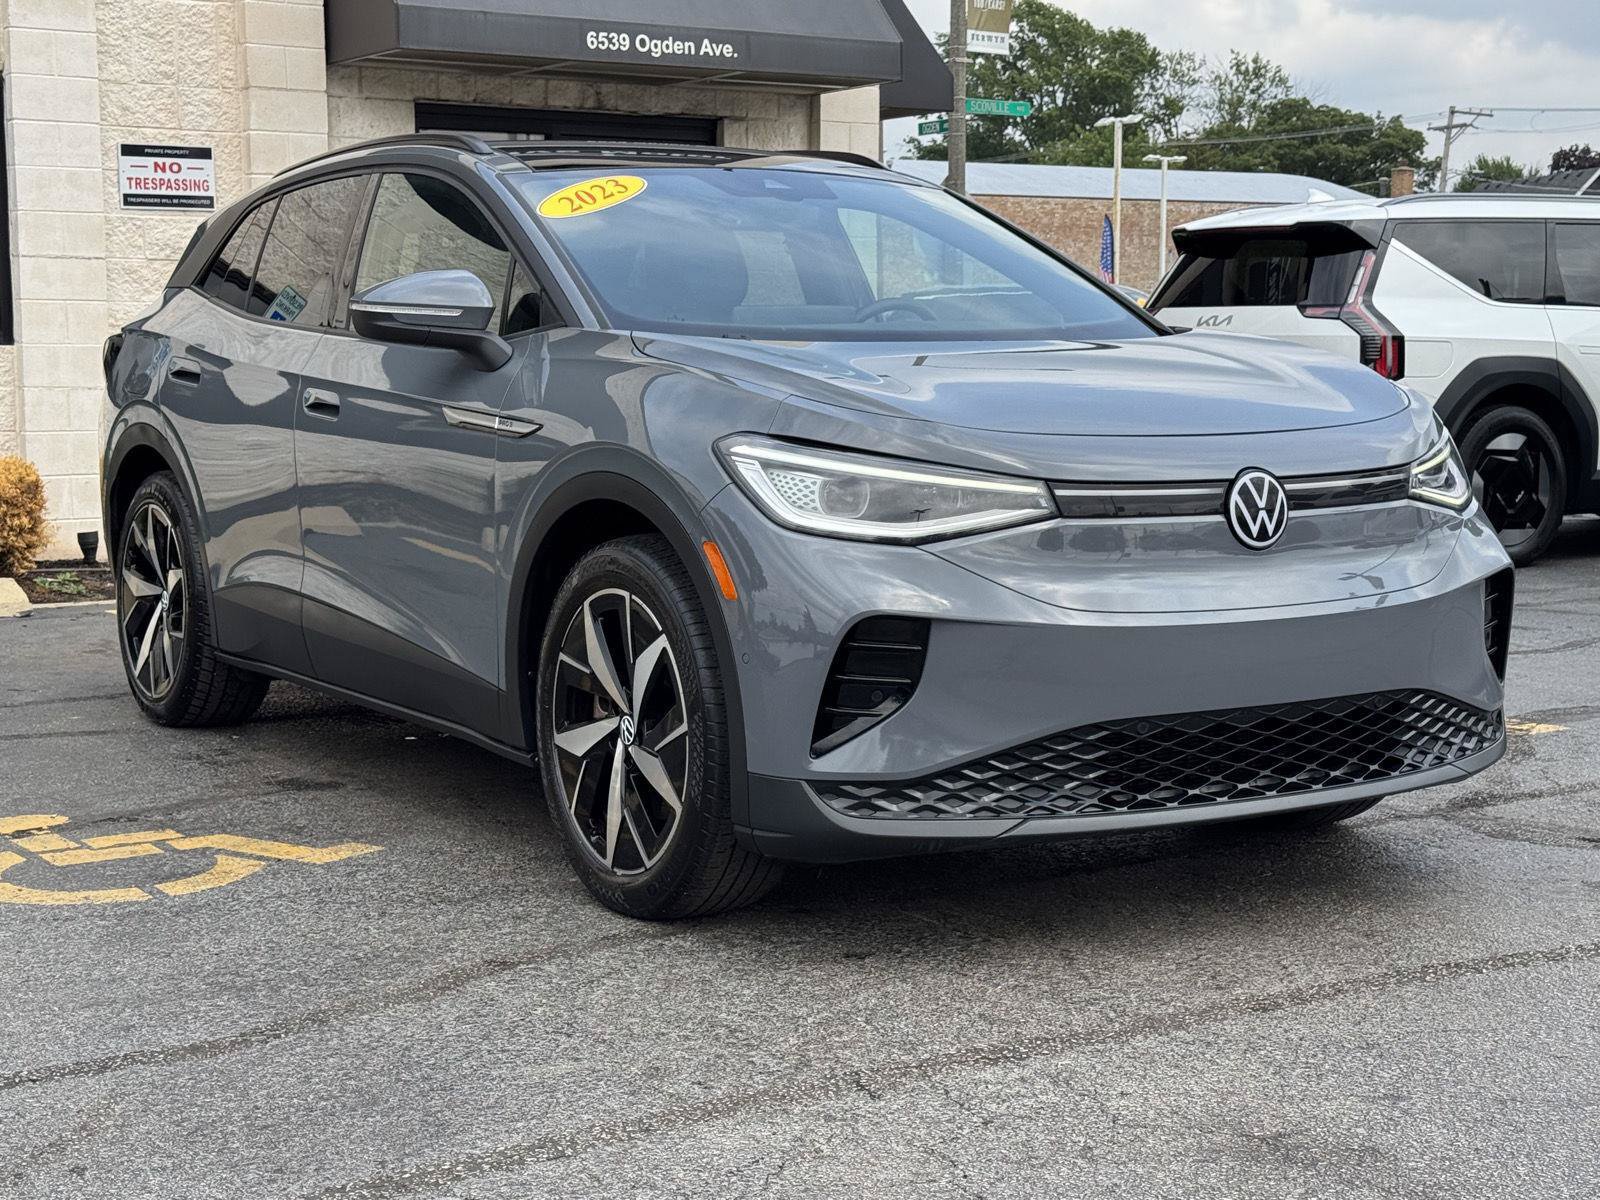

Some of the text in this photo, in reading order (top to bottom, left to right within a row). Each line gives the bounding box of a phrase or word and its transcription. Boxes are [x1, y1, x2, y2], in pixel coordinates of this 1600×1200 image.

[586, 31, 738, 58] 6539 Ogden Ave.
[970, 100, 1010, 112] SCOVILLE
[153, 161, 183, 174] NO
[126, 177, 210, 192] TRESPASSING
[558, 179, 629, 213] 2023
[1229, 471, 1288, 547] VW
